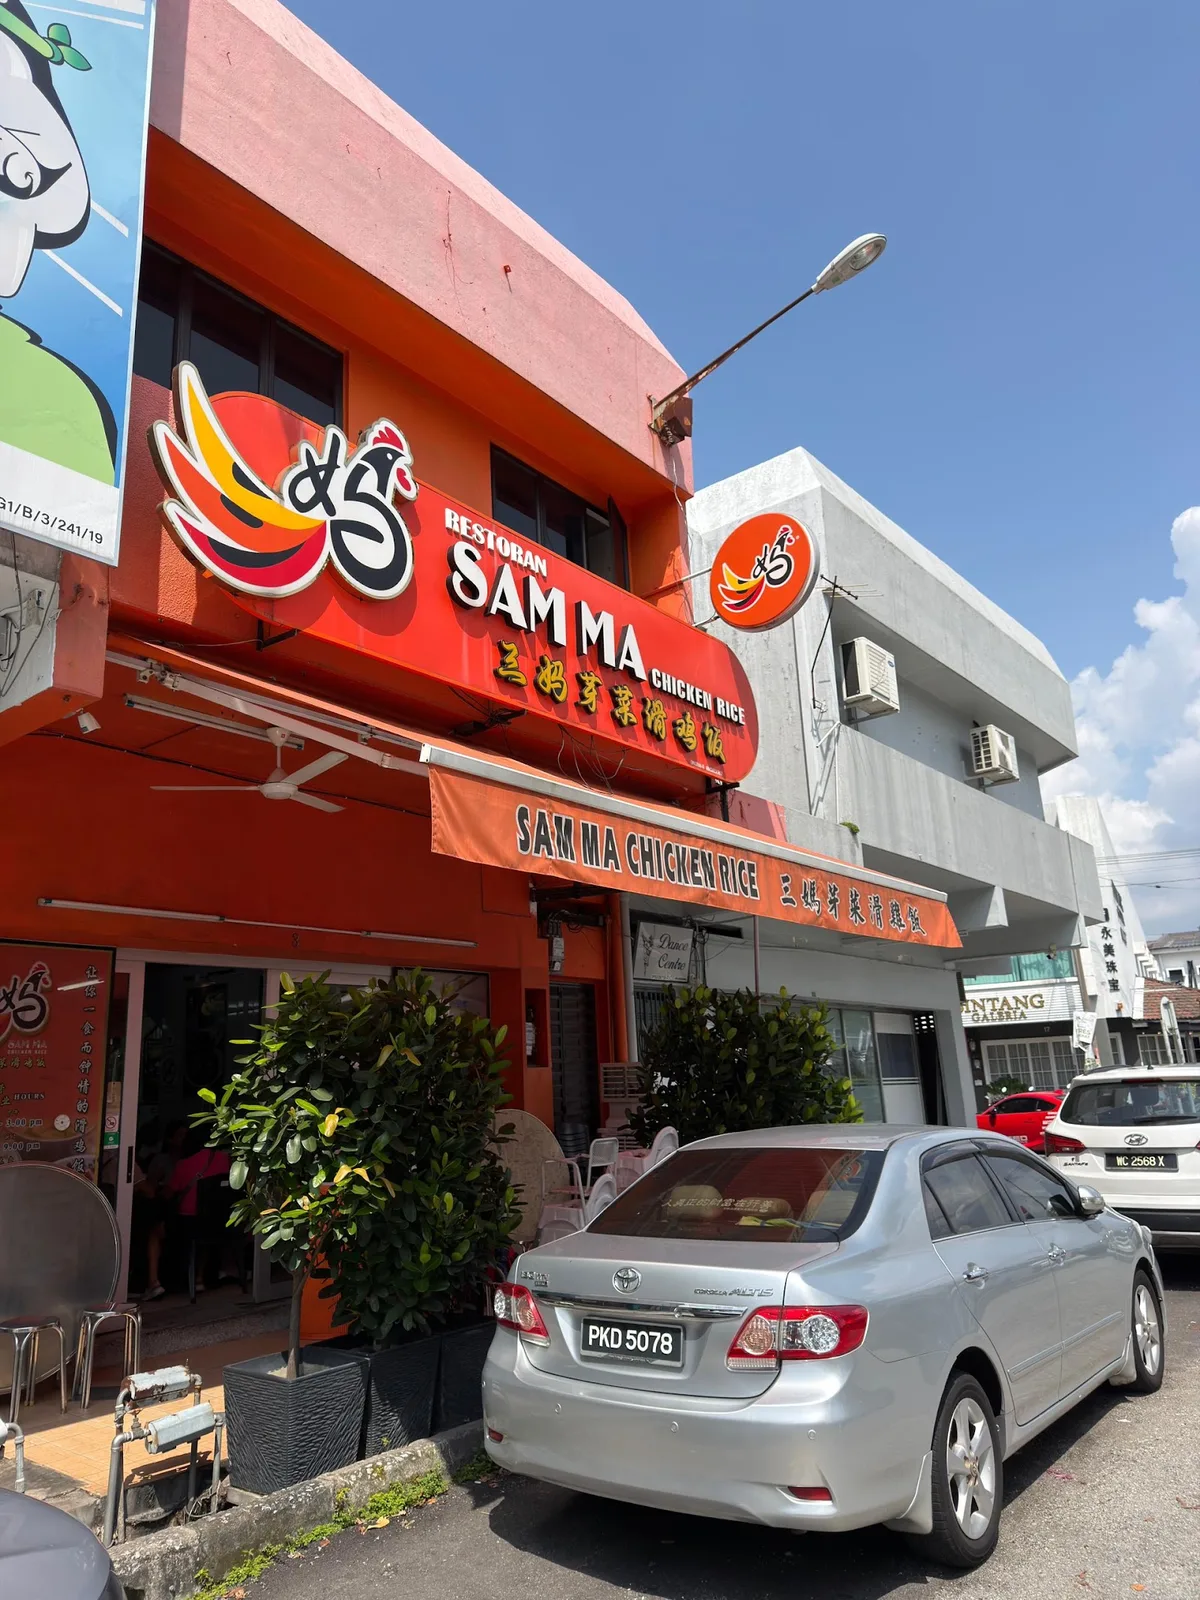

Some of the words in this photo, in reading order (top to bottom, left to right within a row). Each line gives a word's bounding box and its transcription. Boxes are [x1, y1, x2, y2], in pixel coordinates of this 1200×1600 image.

[445, 508, 547, 577] RESTORAN
[446, 540, 567, 647] SAM
[576, 600, 647, 682] MA
[650, 668, 712, 711] CHICKEN
[716, 696, 746, 726] RICE
[515, 804, 576, 864] SAM
[580, 820, 622, 873] MA
[625, 832, 717, 891] CHICKEN
[717, 853, 760, 900] RICE
[658, 933, 689, 952] Dance
[658, 953, 686, 970] Centre
[971, 1009, 1027, 1022] GALERIA
[29, 1118, 43, 1129] pm
[26, 1142, 41, 1152] pm
[1116, 1156, 1129, 1167] WC
[1131, 1155, 1156, 1167] 2568
[1158, 1155, 1165, 1167] X
[728, 1287, 774, 1297] ALTIS
[588, 1324, 622, 1349] PKD
[625, 1329, 673, 1355] 5078
